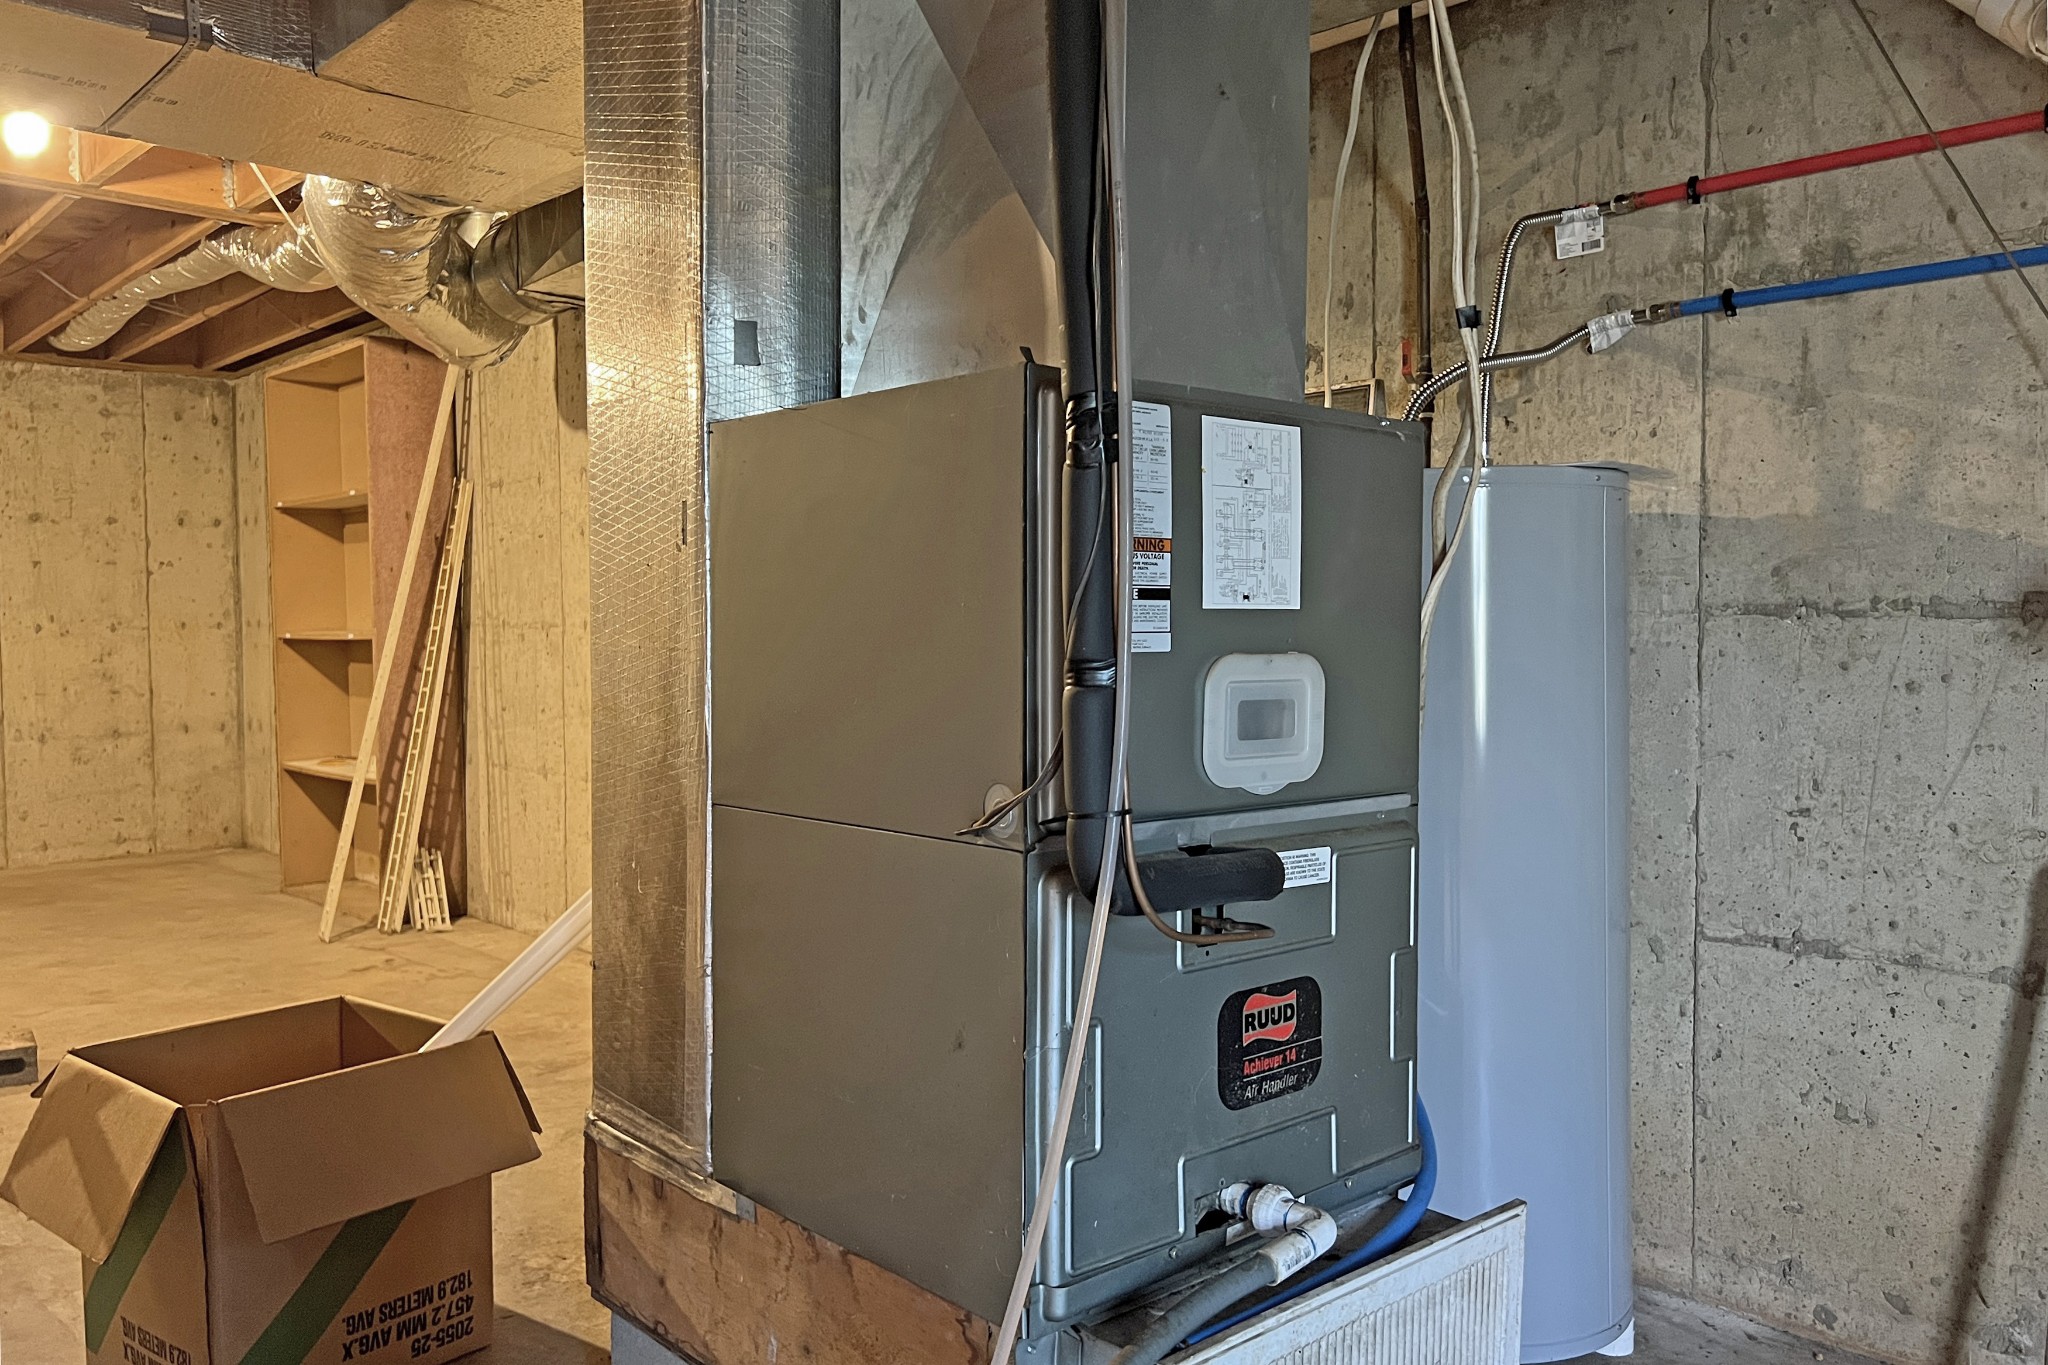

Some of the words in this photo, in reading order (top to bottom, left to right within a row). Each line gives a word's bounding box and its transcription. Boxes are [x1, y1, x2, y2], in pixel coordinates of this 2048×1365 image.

[1244, 1003, 1295, 1034] RUUD
[1244, 1053, 1283, 1076] Achiever
[1285, 1048, 1297, 1063] 14
[1244, 1084, 1260, 1100] Air
[1261, 1073, 1299, 1096] Handler
[437, 1269, 472, 1301] 182.9
[379, 1284, 434, 1324] METERS
[431, 1294, 474, 1327] 457.2
[120, 1315, 136, 1342] AVG.
[342, 1307, 375, 1336] AVG.
[396, 1311, 427, 1342] MM
[411, 1315, 474, 1359] 2055-25
[138, 1326, 167, 1362] METERS
[342, 1325, 392, 1362] AVG.X
